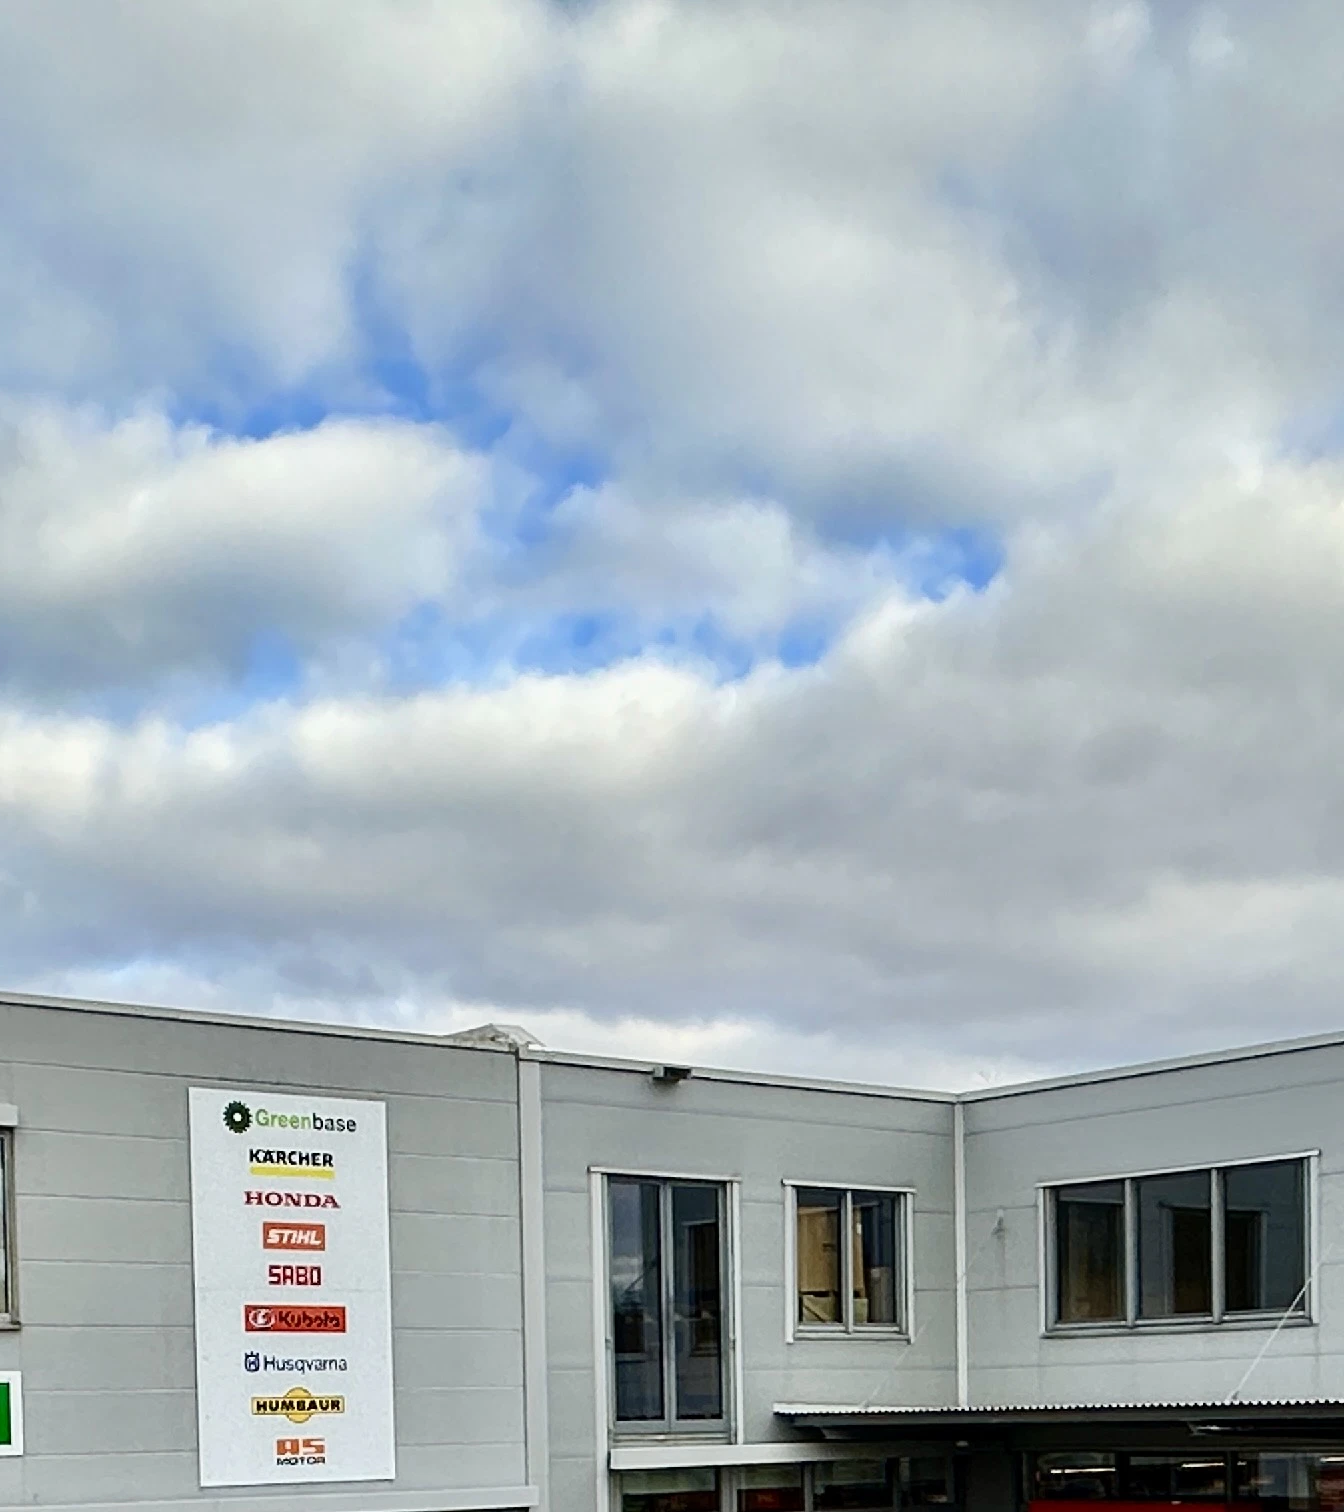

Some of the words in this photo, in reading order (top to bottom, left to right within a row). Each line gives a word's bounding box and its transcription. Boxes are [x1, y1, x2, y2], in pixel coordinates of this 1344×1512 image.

[255, 1109, 357, 1132] Greenbase
[249, 1148, 334, 1167] KÄRCHER
[244, 1191, 341, 1209] HONDA
[267, 1228, 322, 1246] STIHL
[268, 1264, 322, 1286] SABO
[278, 1310, 340, 1328] Kubota
[263, 1355, 348, 1375] Husqvarna
[256, 1399, 341, 1412] HUMBAUR
[276, 1438, 326, 1455] AS
[276, 1456, 326, 1466] MOTOR
